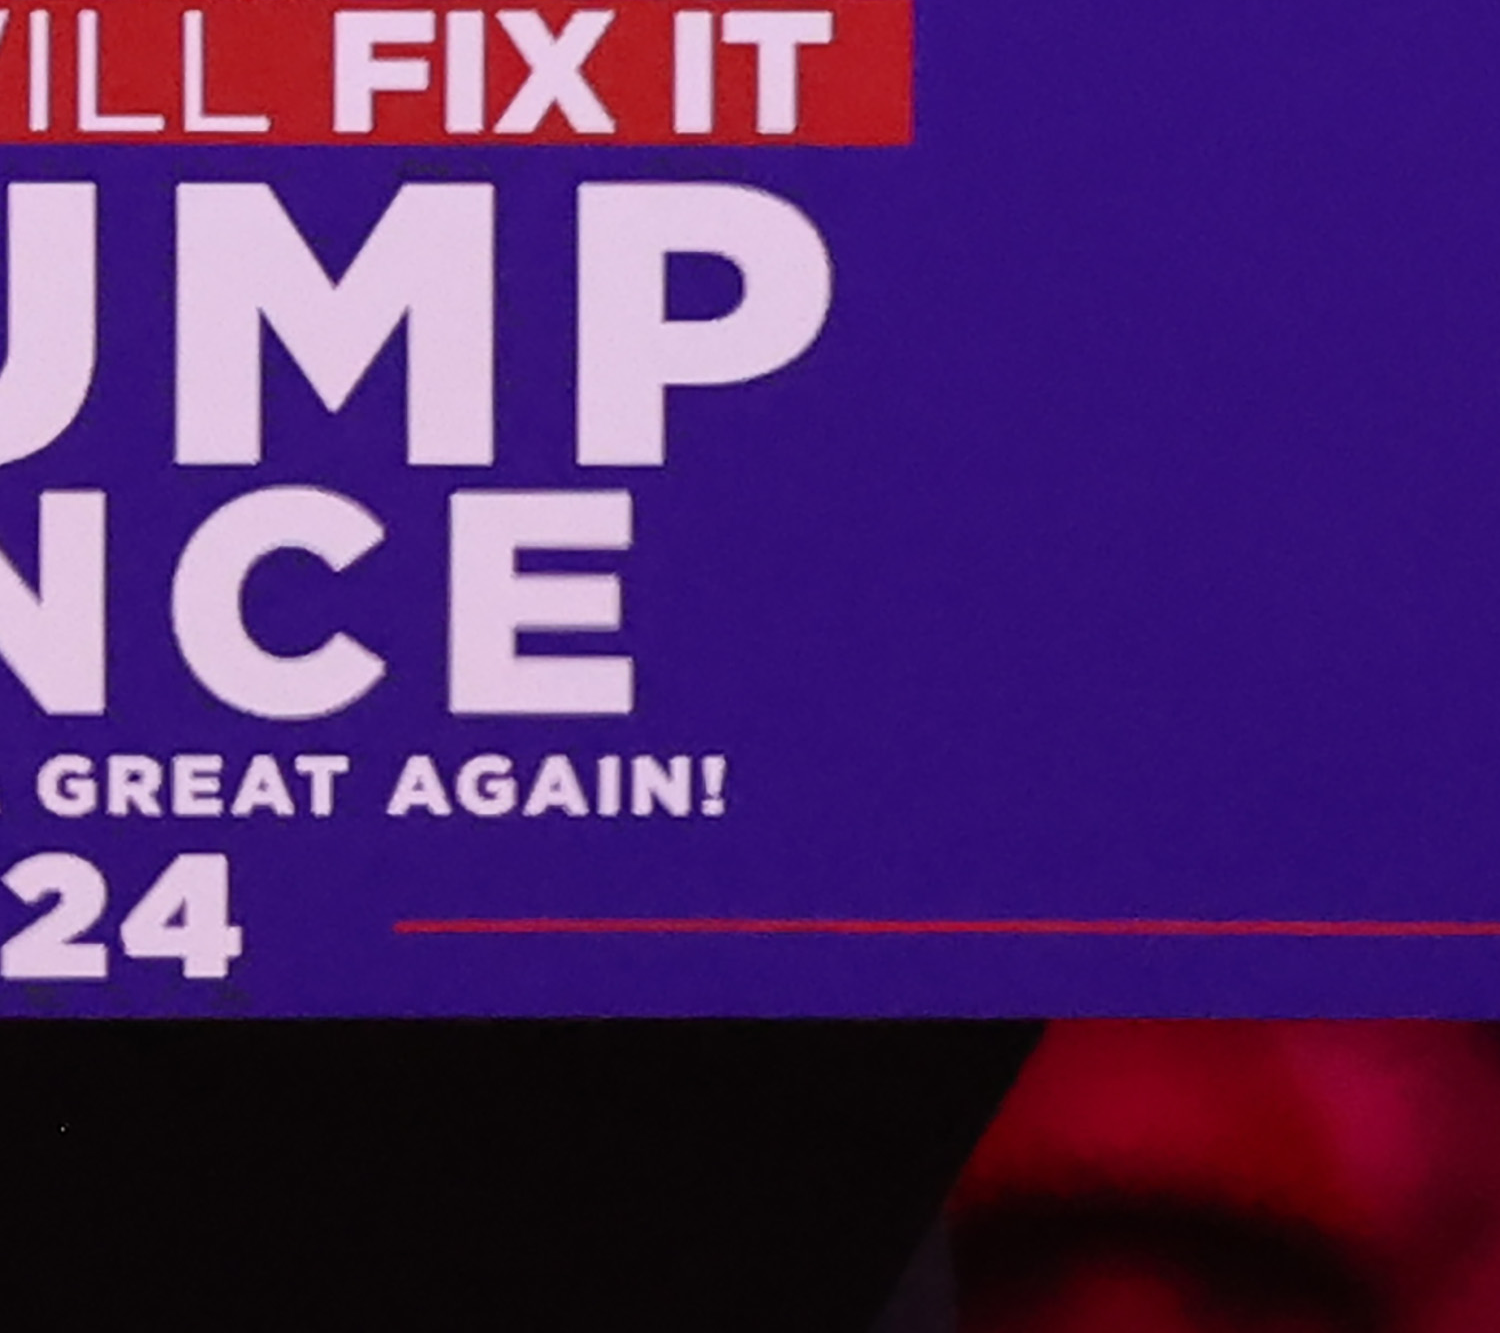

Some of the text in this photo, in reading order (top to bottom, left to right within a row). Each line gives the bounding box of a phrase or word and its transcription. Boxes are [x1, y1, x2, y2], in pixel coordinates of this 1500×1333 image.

[334, 10, 615, 133] FIX
[674, 11, 832, 134] IT
[38, 755, 348, 816] GREAT
[387, 755, 725, 816] AGAIN!
